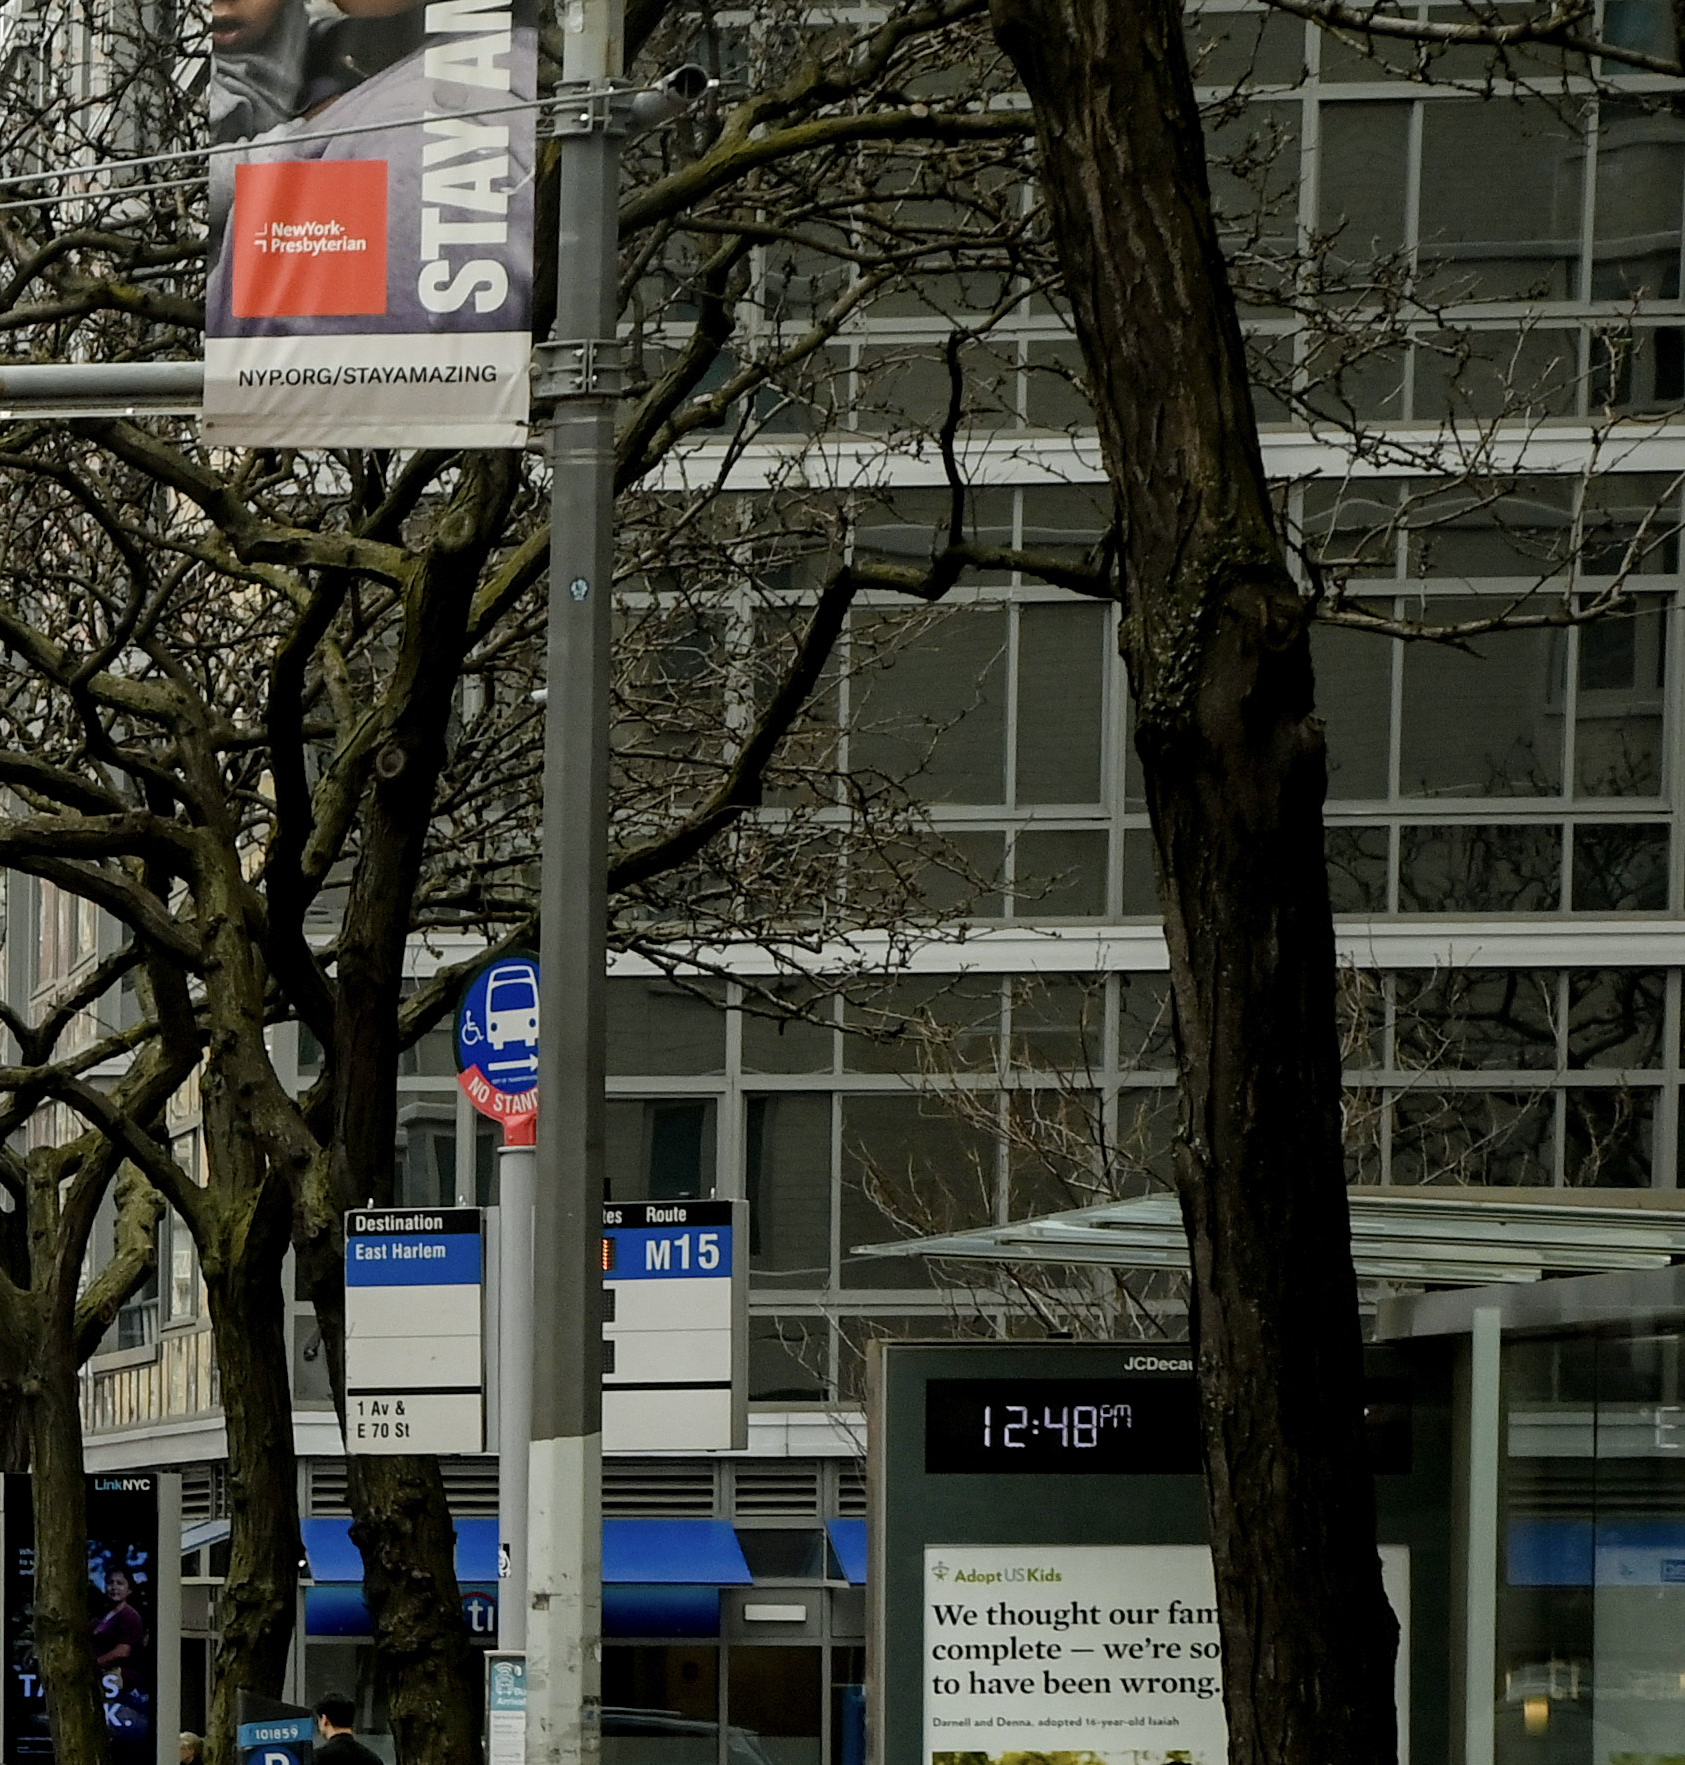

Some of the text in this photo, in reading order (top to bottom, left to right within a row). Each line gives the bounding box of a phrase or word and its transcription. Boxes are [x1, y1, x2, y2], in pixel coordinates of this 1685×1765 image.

[418, 112, 511, 314] STAY
[271, 235, 367, 257] Presbyterian
[238, 364, 498, 388] NYP.ORG/STAYAMAZING
[468, 1076, 490, 1104] NO
[355, 1213, 443, 1233] Destination
[645, 1204, 687, 1225] Route
[355, 1241, 446, 1261] East Harlem
[645, 1232, 720, 1271] M15
[371, 1401, 406, 1417] Av &
[357, 1422, 410, 1439] E 70 St
[983, 1405, 1098, 1448] 12:48
[95, 1479, 150, 1491] LinkNYC
[931, 1601, 1159, 1632] We thought our
[931, 1637, 1062, 1666] complete
[1189, 1640, 1222, 1660] so
[932, 1670, 1222, 1700] to have been wrong.
[255, 1727, 299, 1740] 101859
[973, 1717, 993, 1728] and
[1037, 1717, 1082, 1729] adopted
